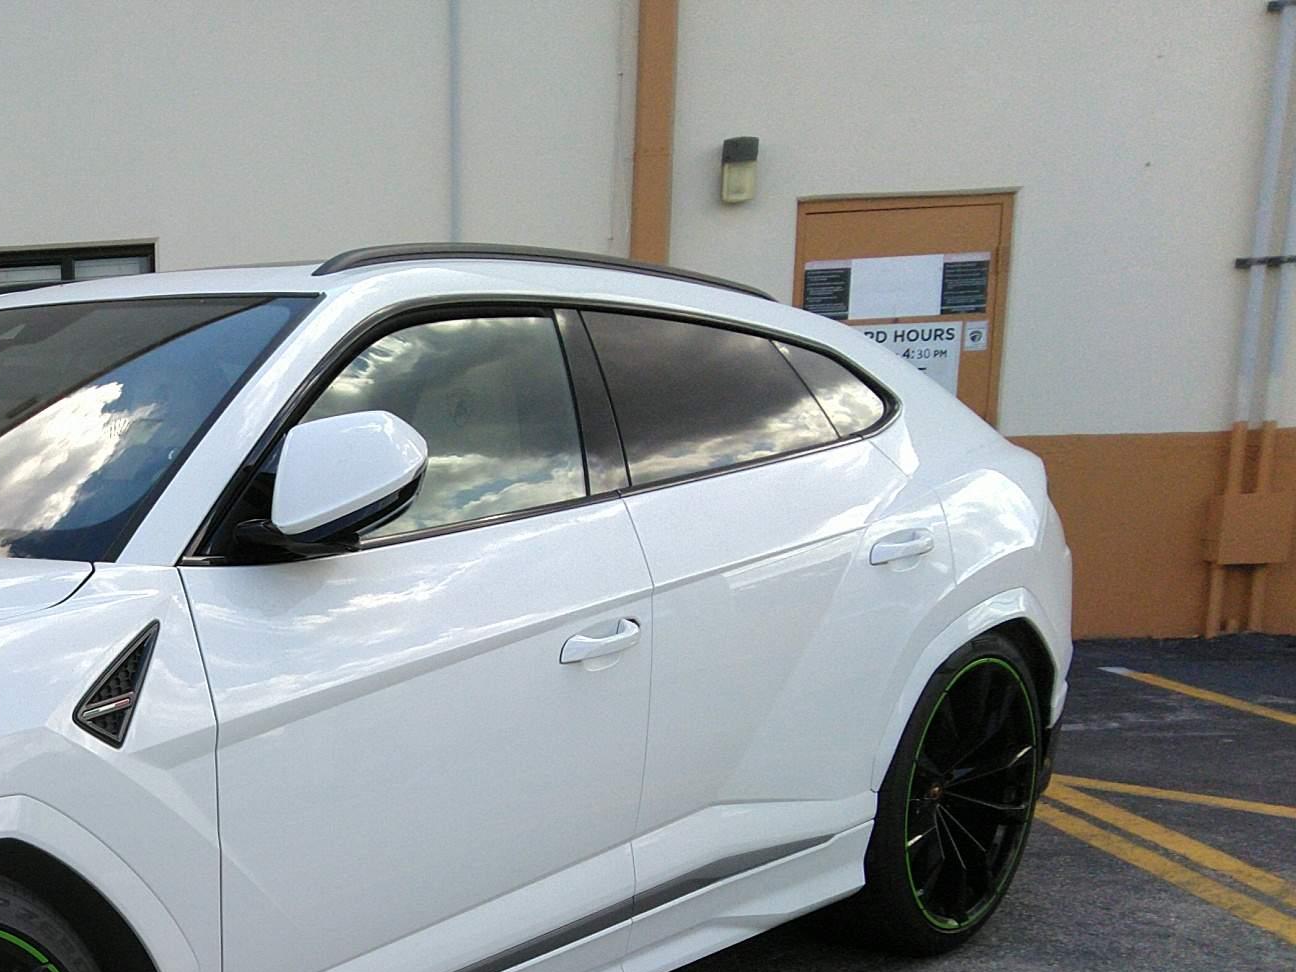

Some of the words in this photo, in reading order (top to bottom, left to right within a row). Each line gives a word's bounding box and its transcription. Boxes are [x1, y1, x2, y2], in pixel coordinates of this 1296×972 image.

[894, 327, 955, 342] HOURS
[902, 347, 931, 359] 4:30
[933, 349, 948, 358] PM
